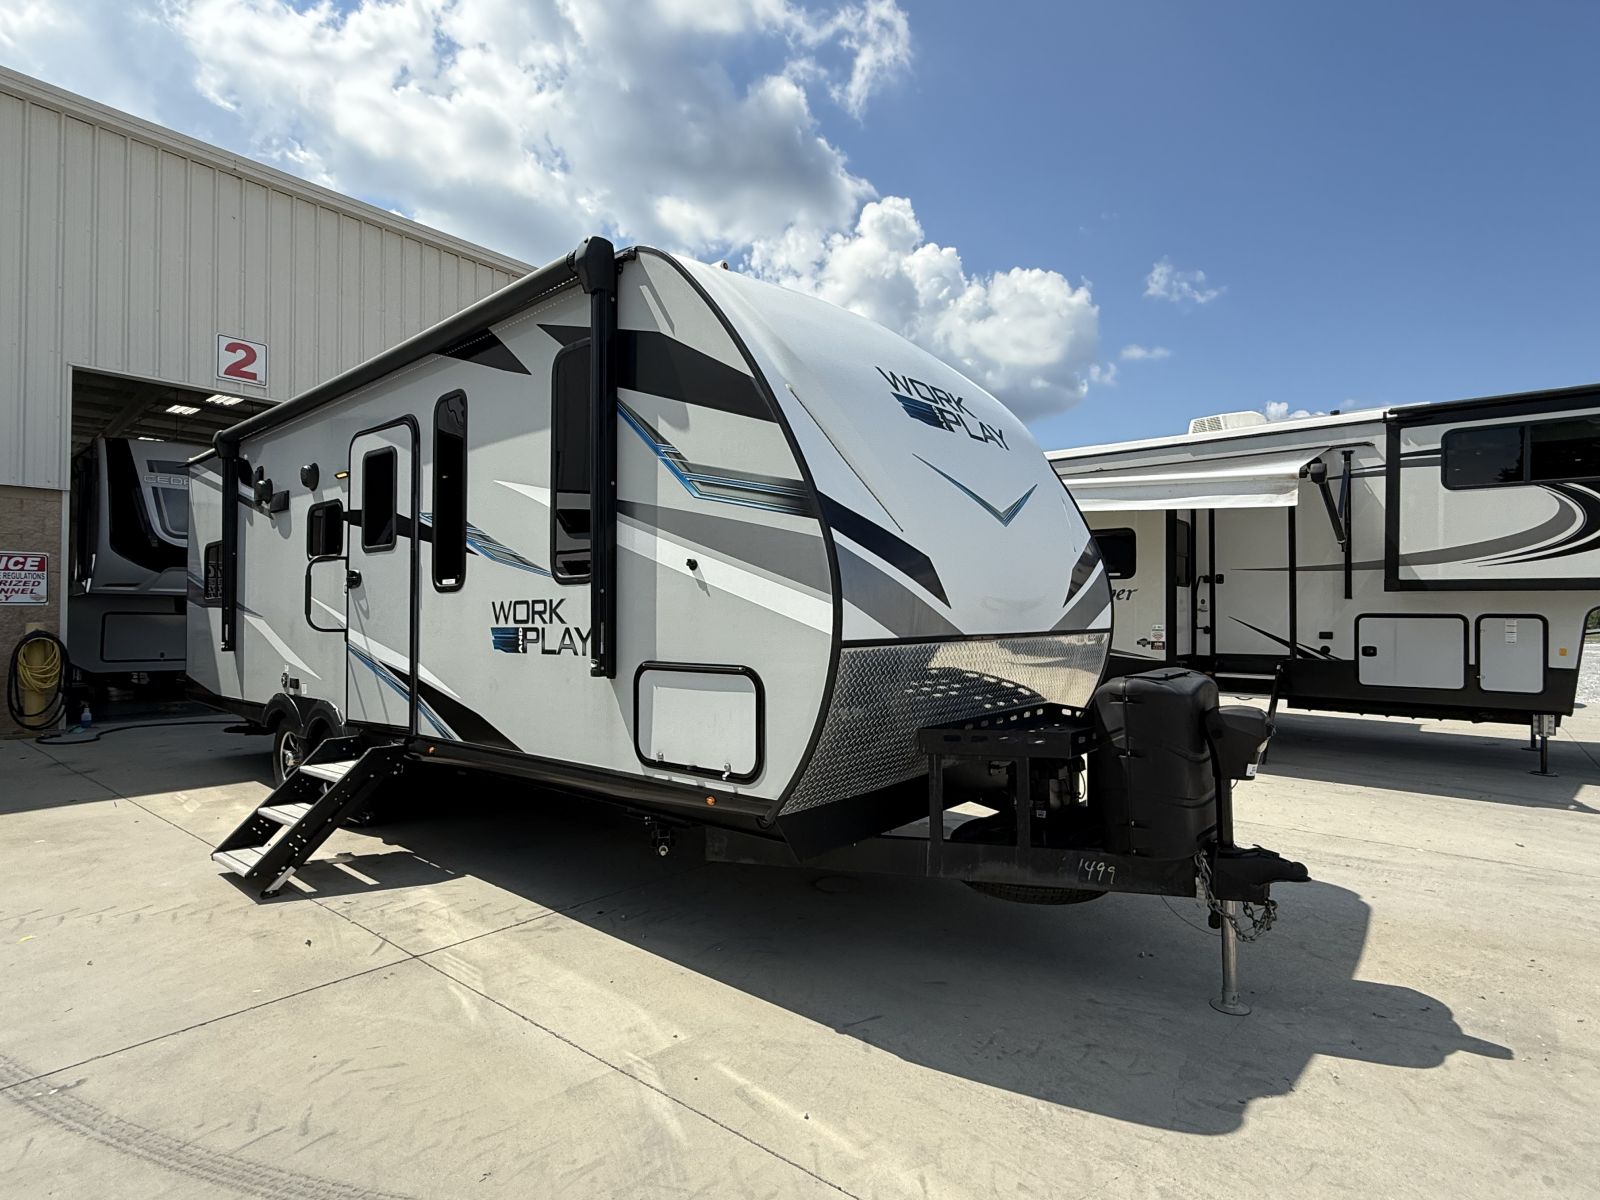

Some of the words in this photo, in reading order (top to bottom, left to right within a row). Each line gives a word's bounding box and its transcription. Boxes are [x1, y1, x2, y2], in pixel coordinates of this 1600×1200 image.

[224, 342, 257, 381] 2
[875, 366, 978, 419] WORK
[936, 406, 1009, 451] PLAY
[3, 572, 45, 580] REGULATIONS
[491, 598, 567, 625] WORK
[523, 626, 591, 656] PLAY
[1078, 858, 1116, 885] 1499
